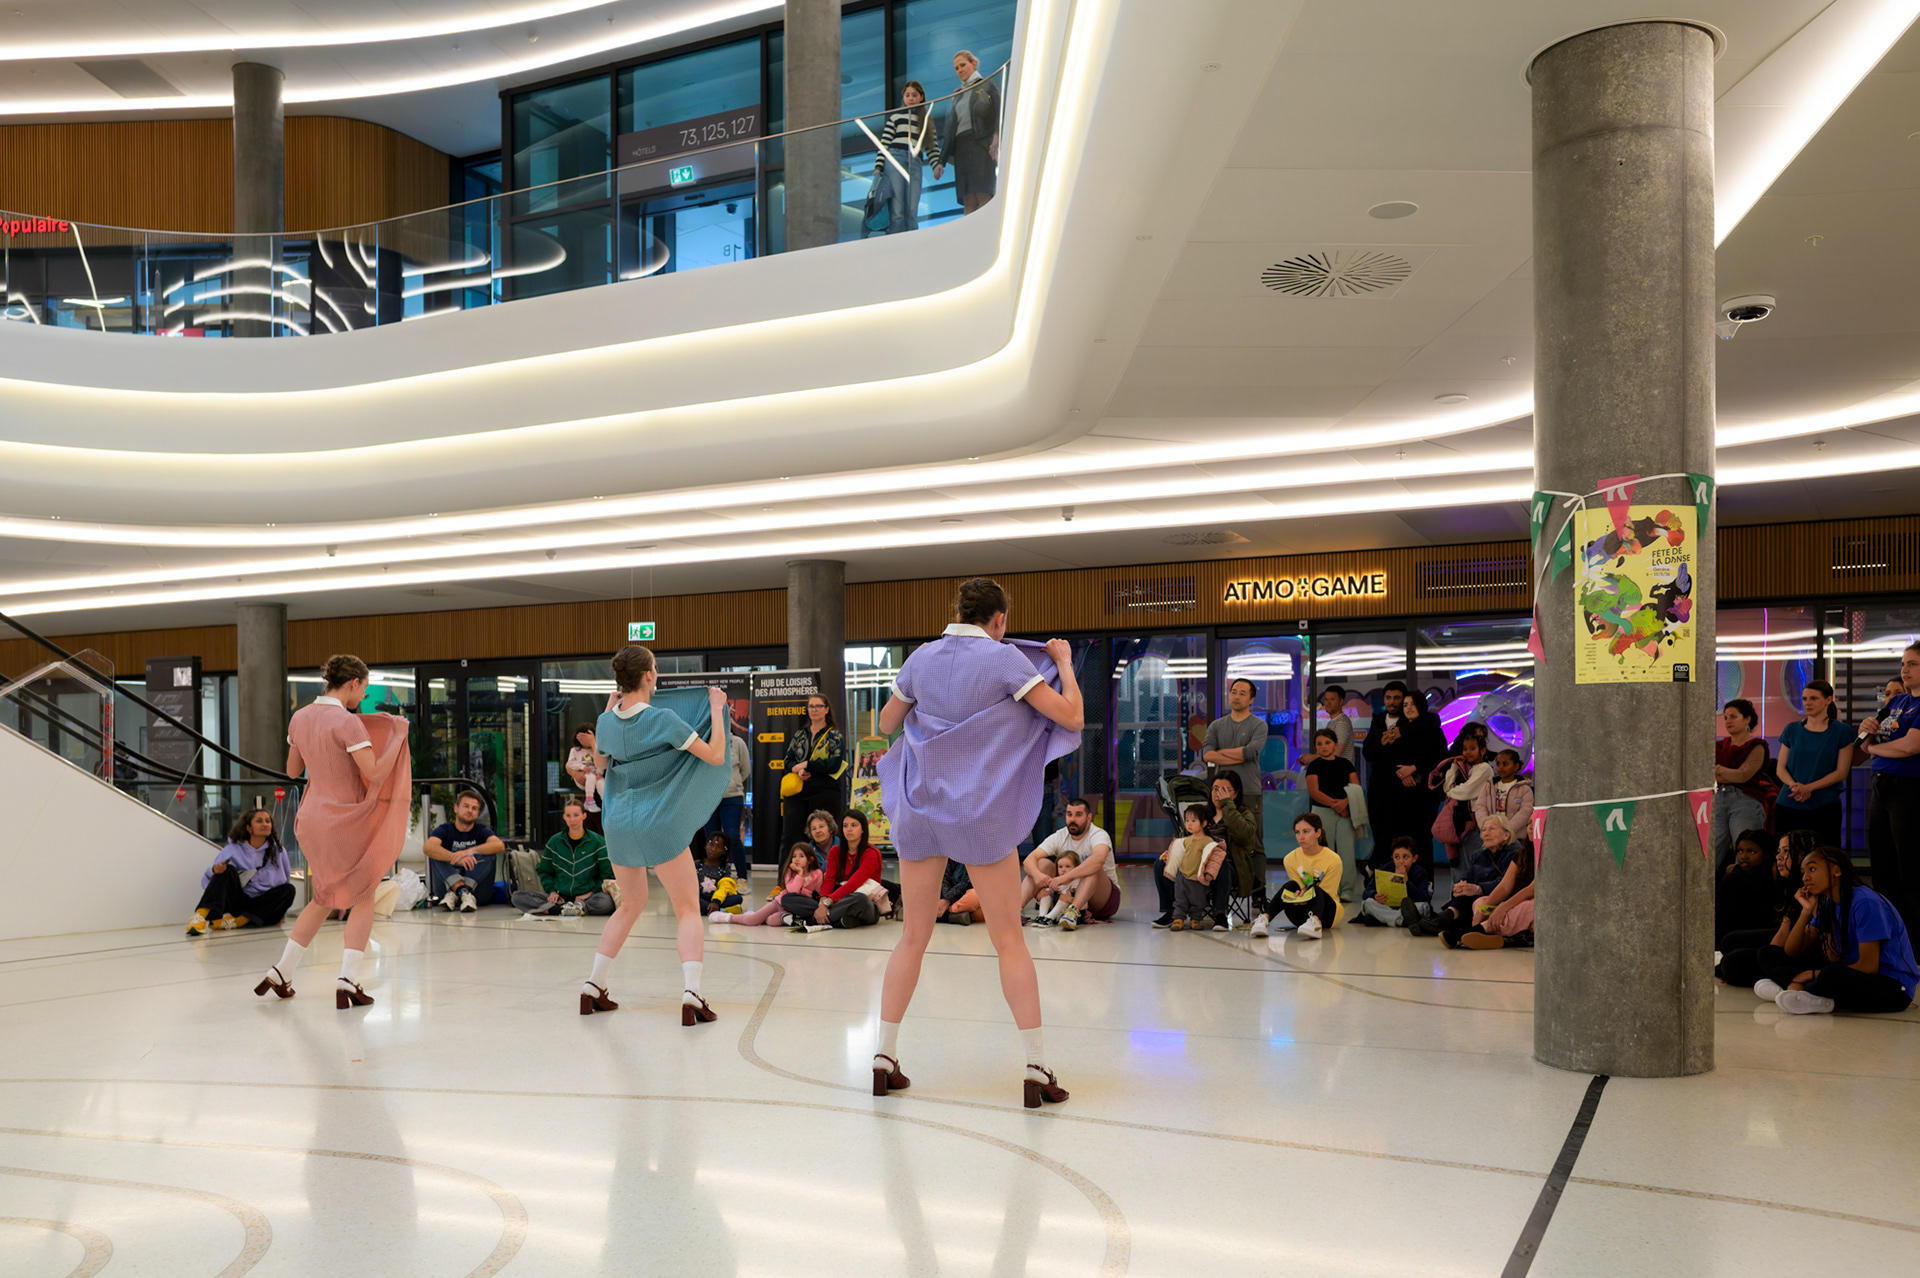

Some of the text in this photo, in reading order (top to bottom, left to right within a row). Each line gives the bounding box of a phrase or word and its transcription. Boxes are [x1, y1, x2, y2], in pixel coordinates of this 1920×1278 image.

[632, 145, 656, 157] HÔTELS
[1672, 547, 1683, 555] DE
[1652, 554, 1691, 566] LA DANSE
[1224, 575, 1385, 601] ATMO GAME
[760, 678, 812, 688] HUB DE LOISIRS
[755, 686, 818, 697] DES ATMOSPHÈRES
[767, 706, 806, 716] BIENVENUE
